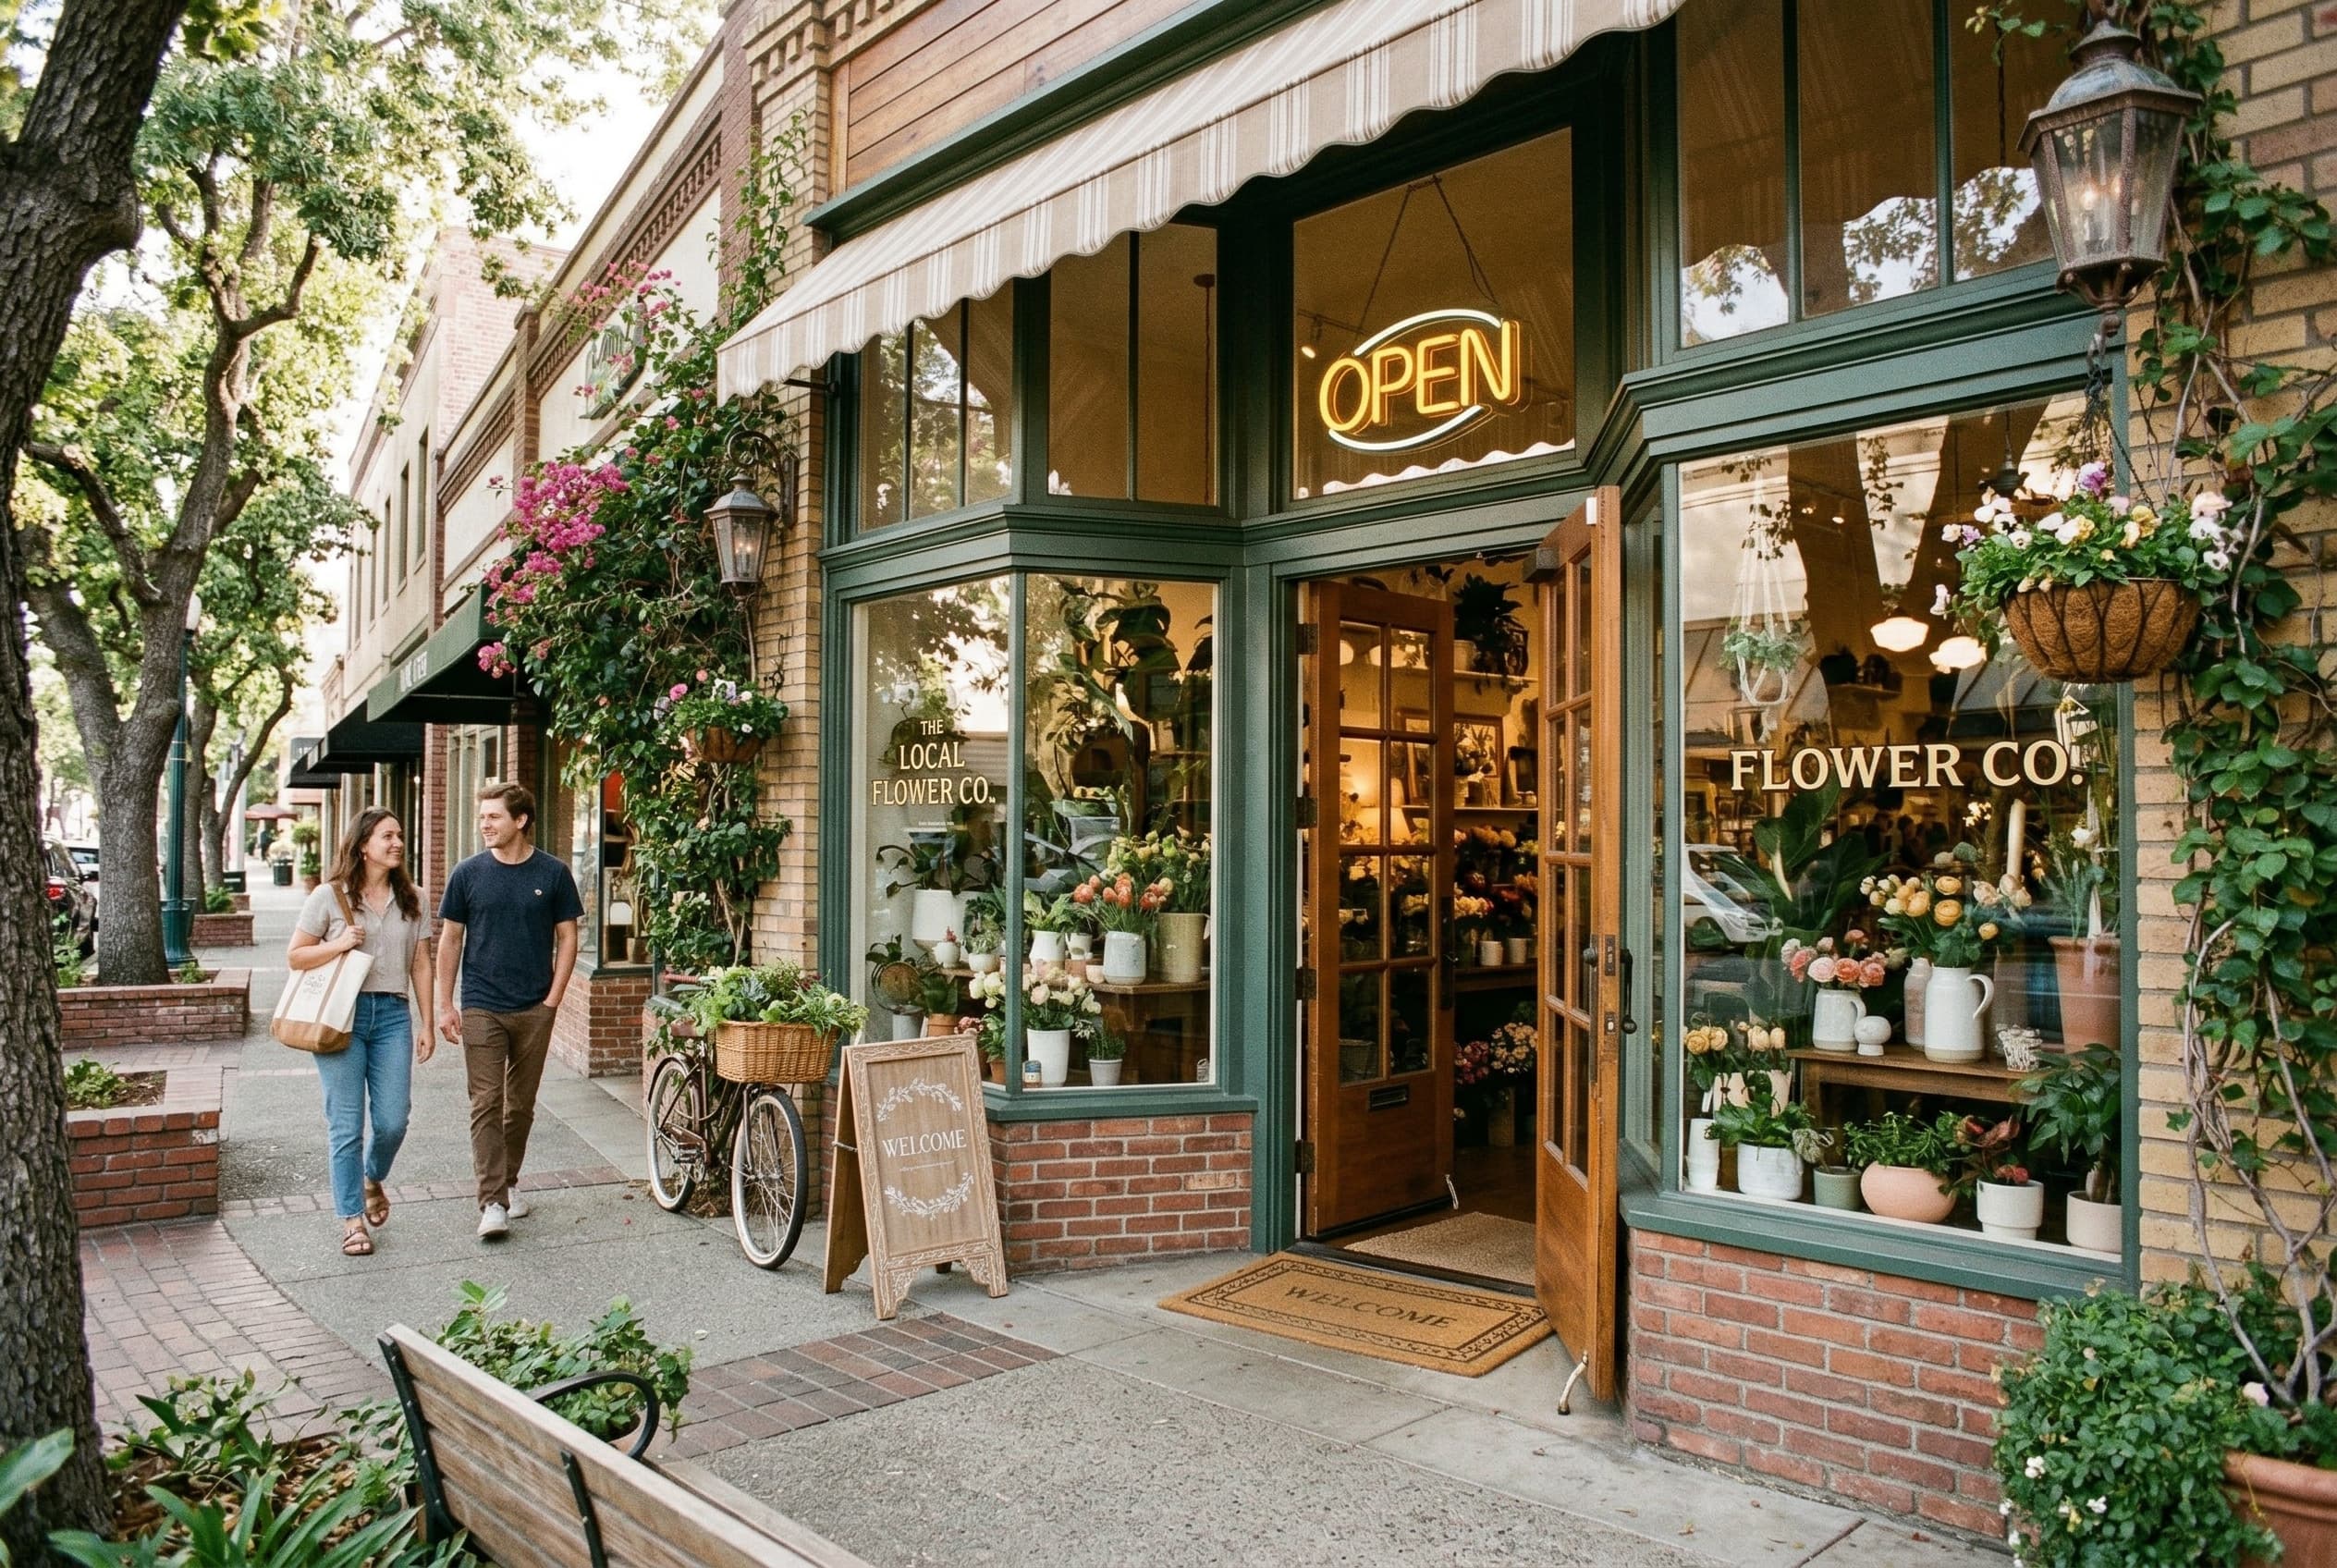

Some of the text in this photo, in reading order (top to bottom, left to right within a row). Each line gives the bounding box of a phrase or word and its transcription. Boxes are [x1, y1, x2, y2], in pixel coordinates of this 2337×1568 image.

[1319, 320, 1519, 432] OPEN
[920, 719, 944, 735] THE
[899, 741, 965, 770] LOCAL
[1730, 740, 2084, 790] FLOWER CO.
[872, 776, 996, 805] FLOWER CO.
[882, 1129, 967, 1158] WELCOME
[1285, 1286, 1458, 1329] WELCOME
